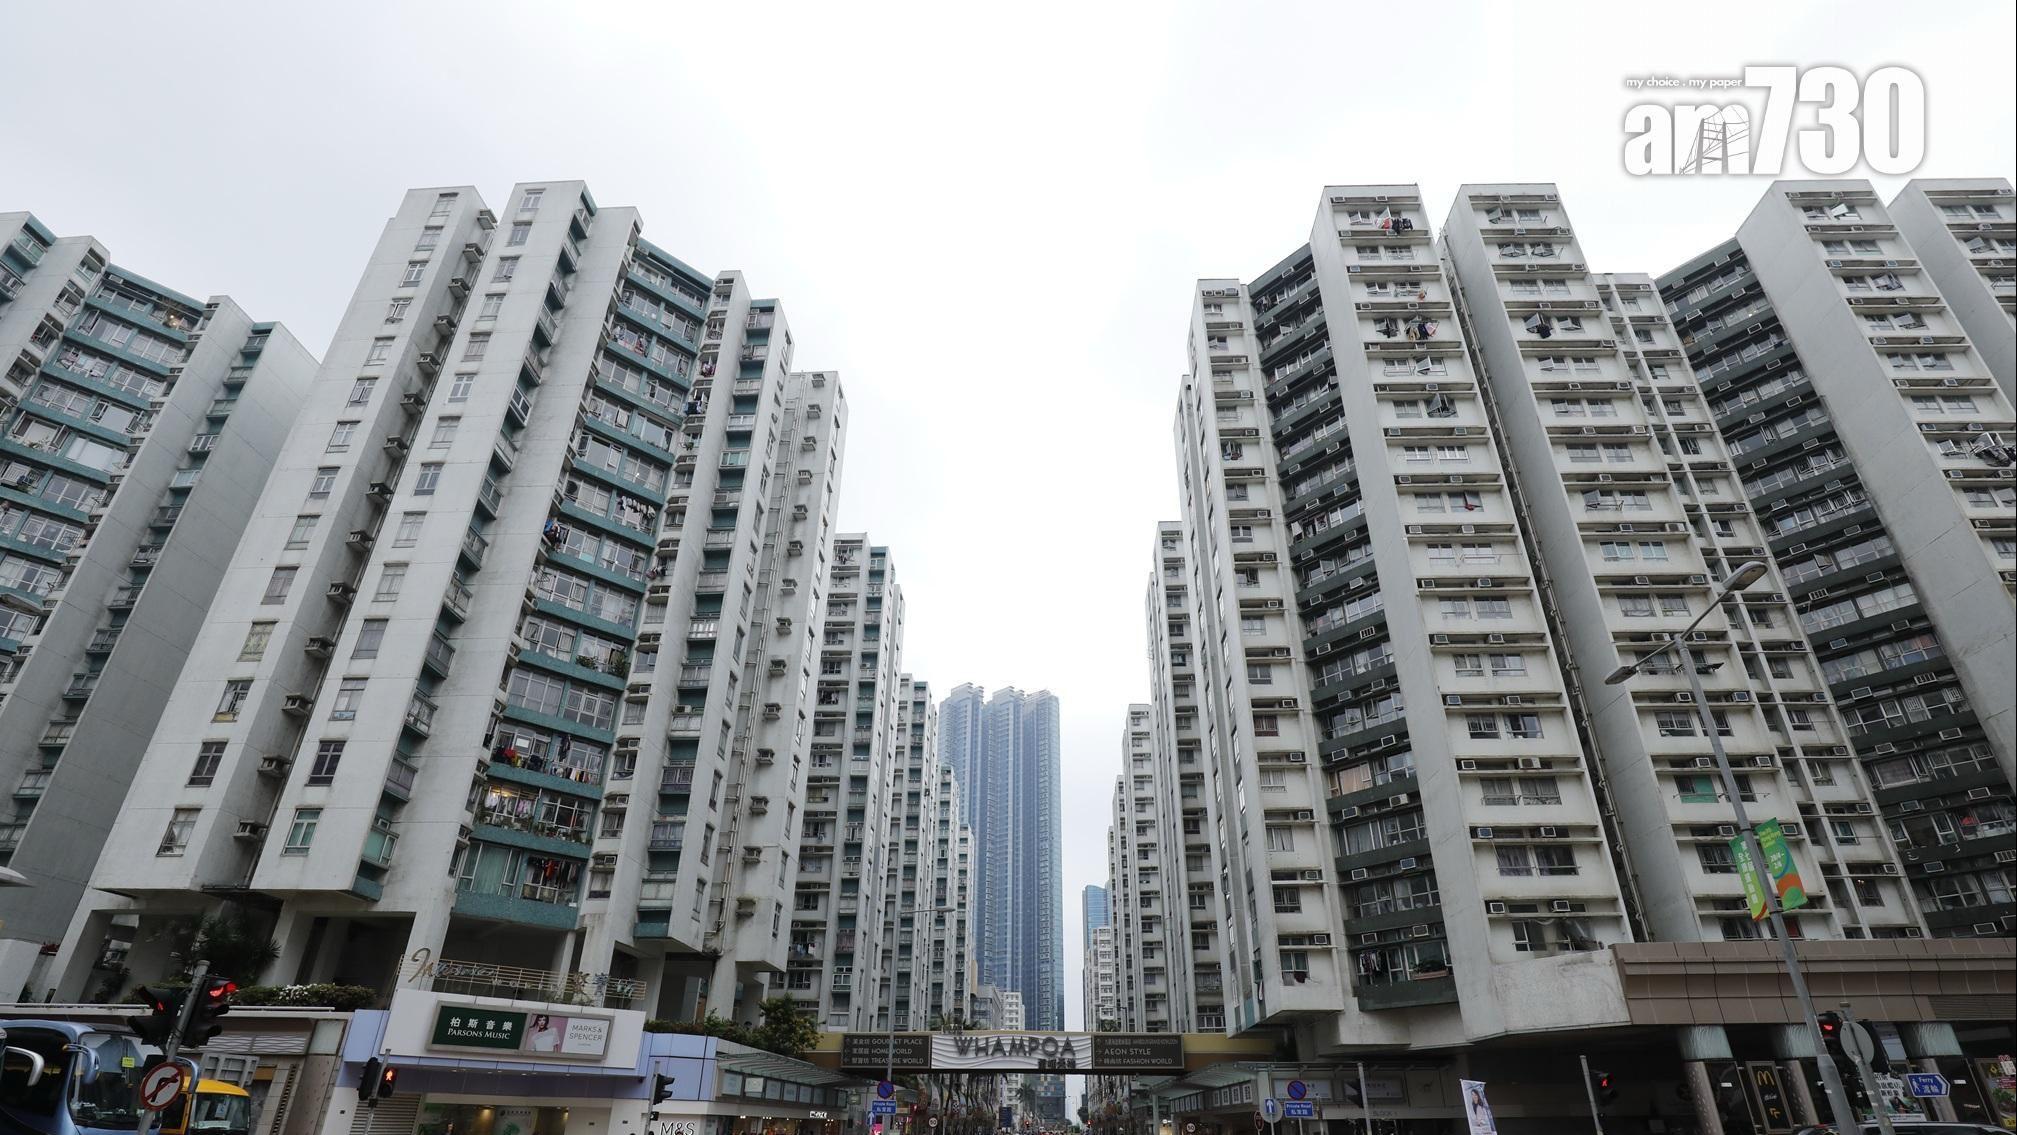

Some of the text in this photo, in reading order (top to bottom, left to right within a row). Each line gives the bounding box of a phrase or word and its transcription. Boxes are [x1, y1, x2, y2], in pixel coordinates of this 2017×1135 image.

[447, 1028, 511, 1040] PARSONS MUSIC
[569, 1032, 603, 1041] SPENCER
[953, 1036, 1076, 1057] WHAMPOA
